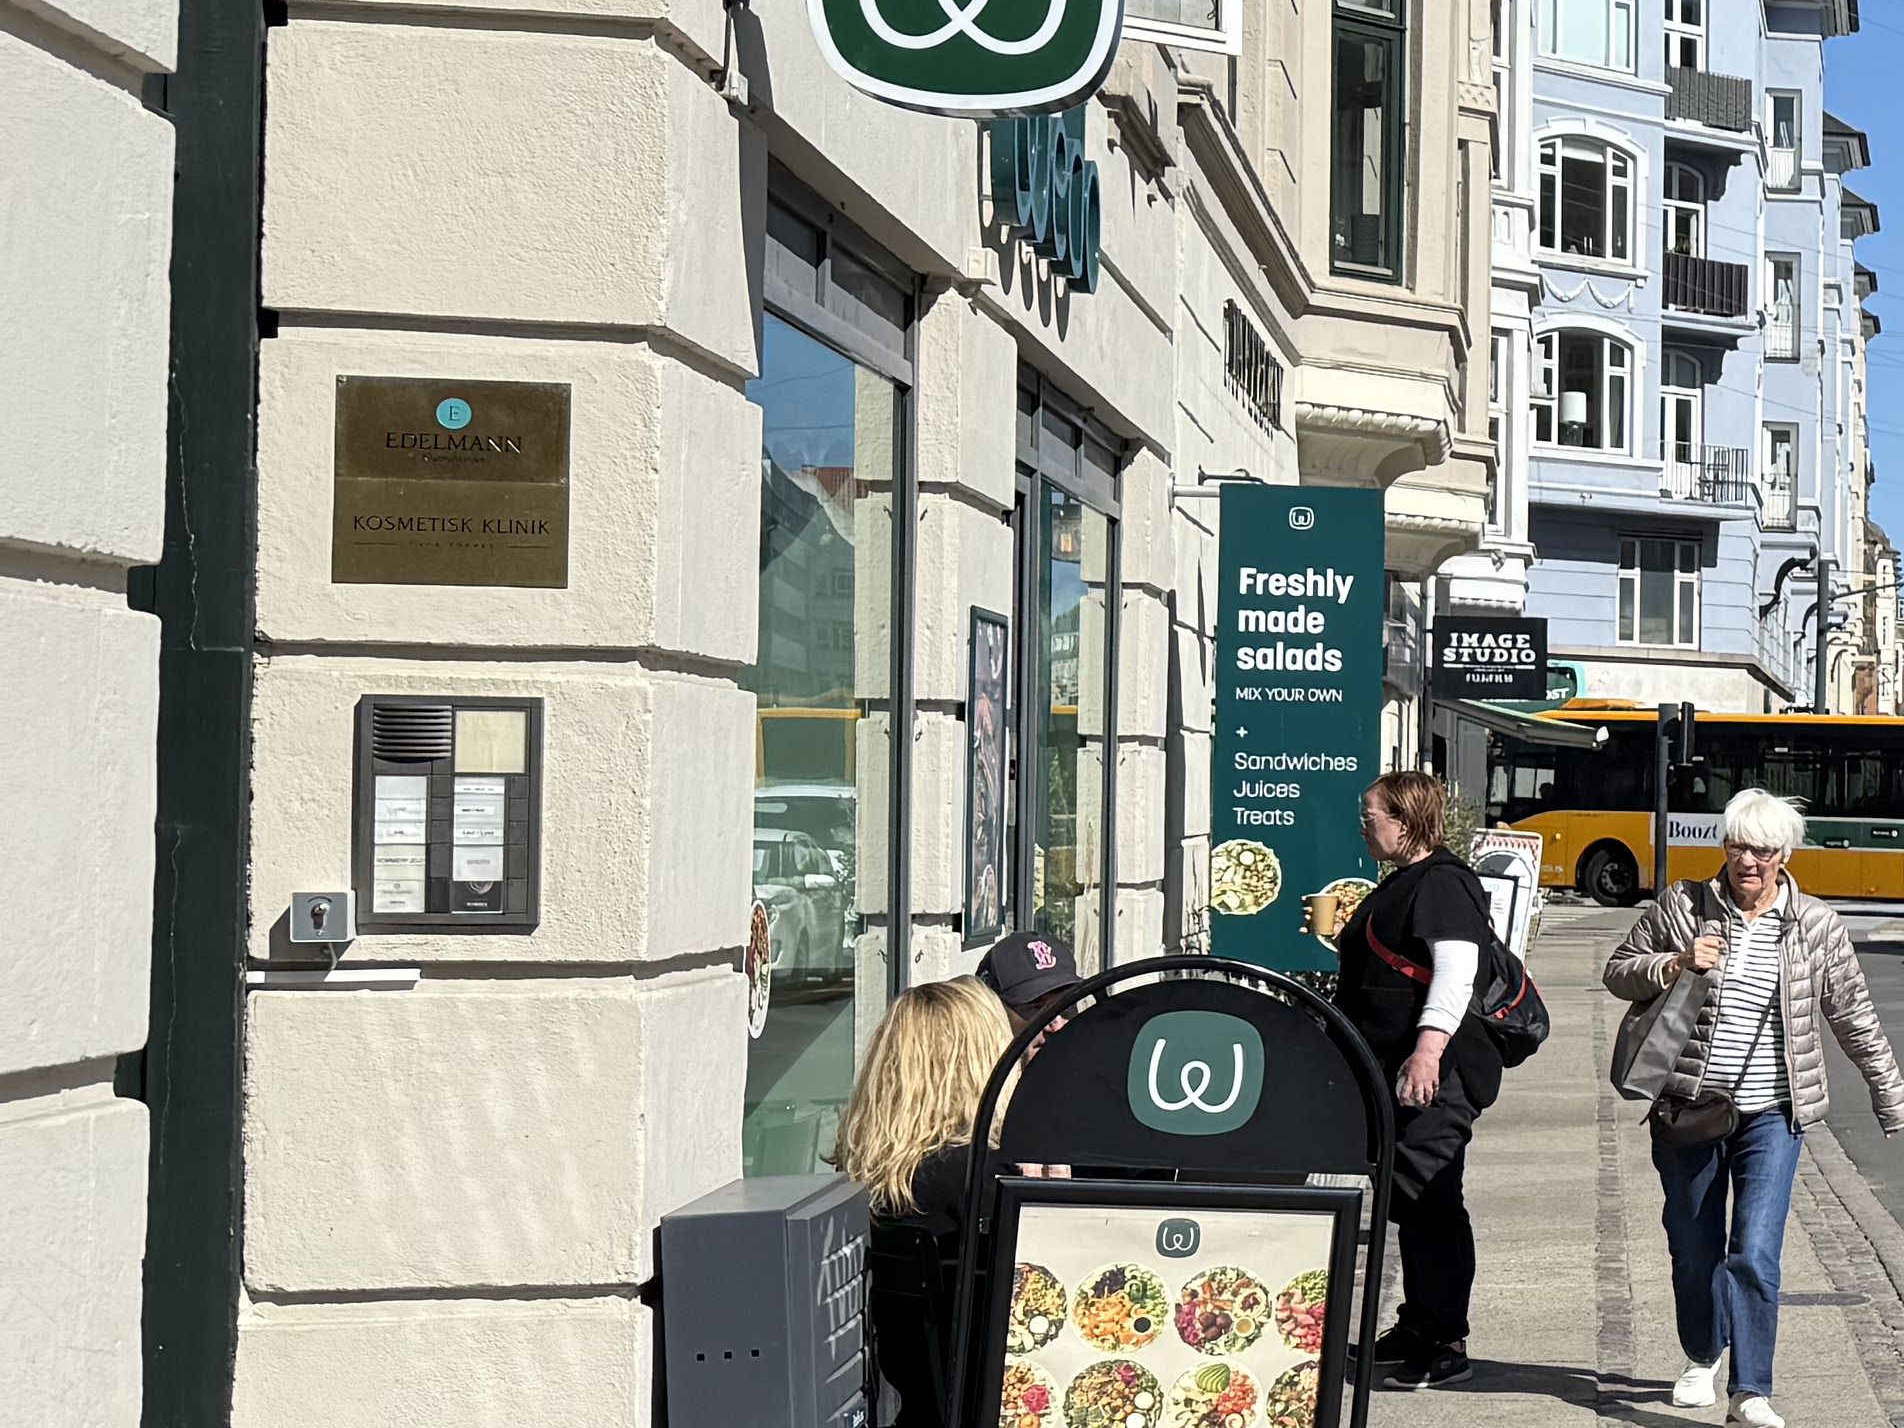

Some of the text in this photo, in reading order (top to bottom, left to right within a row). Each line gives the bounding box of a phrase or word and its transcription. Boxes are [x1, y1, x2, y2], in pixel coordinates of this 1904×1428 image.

[386, 432, 522, 453] EDELMANN
[353, 515, 551, 535] KOSMETISK KLINIK
[1239, 567, 1354, 604] Freshly
[1238, 604, 1325, 634] made
[1450, 632, 1531, 648] IMAGE
[1236, 641, 1343, 672] salads
[1442, 647, 1536, 663] STUDIO
[1235, 687, 1343, 702] MIX YOUR OWN
[1234, 752, 1358, 771] Sandwiches
[1233, 780, 1300, 798] Juices
[1233, 807, 1295, 826] Treats
[1668, 821, 1719, 840] Boozt
